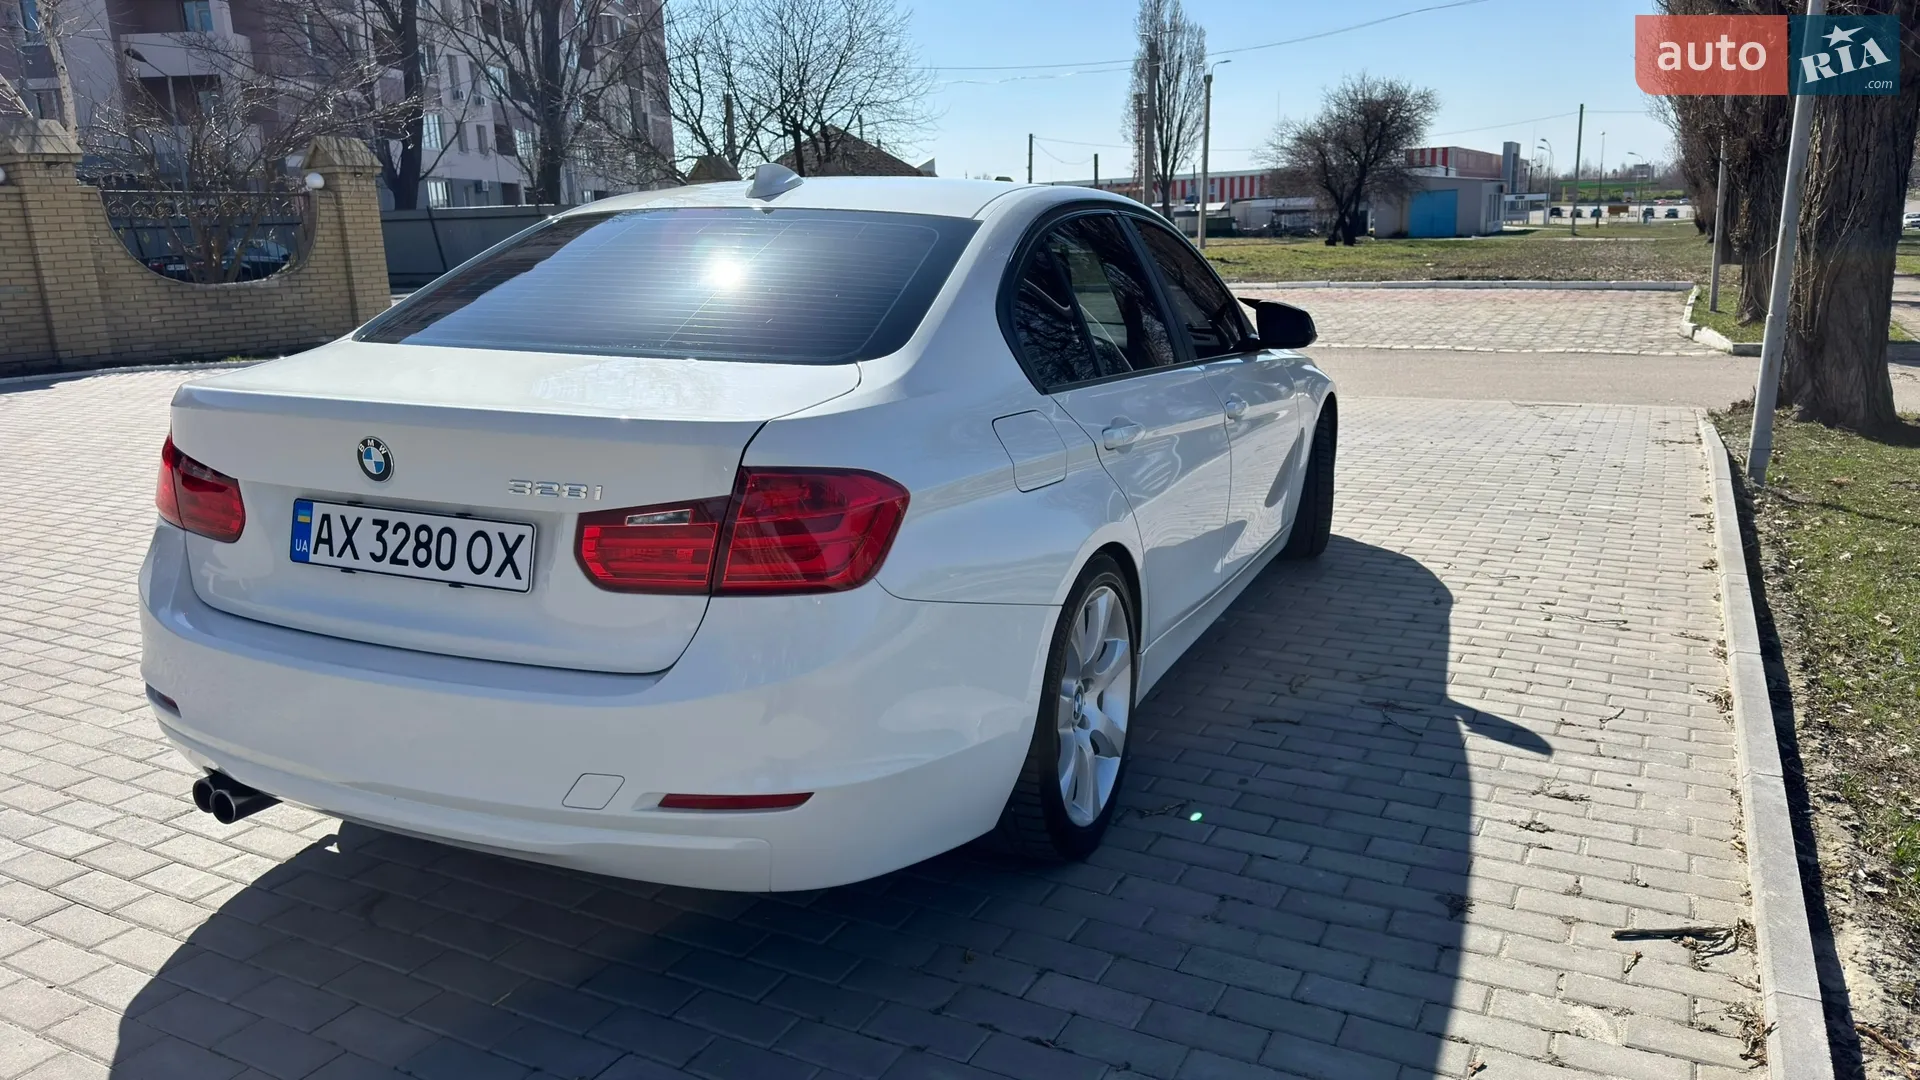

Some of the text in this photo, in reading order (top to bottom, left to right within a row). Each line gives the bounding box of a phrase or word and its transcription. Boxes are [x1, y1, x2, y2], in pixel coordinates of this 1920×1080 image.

[358, 439, 387, 455] BMW
[508, 478, 603, 501] 328i
[295, 538, 308, 553] UA
[313, 513, 526, 580] AX 3280 OX
